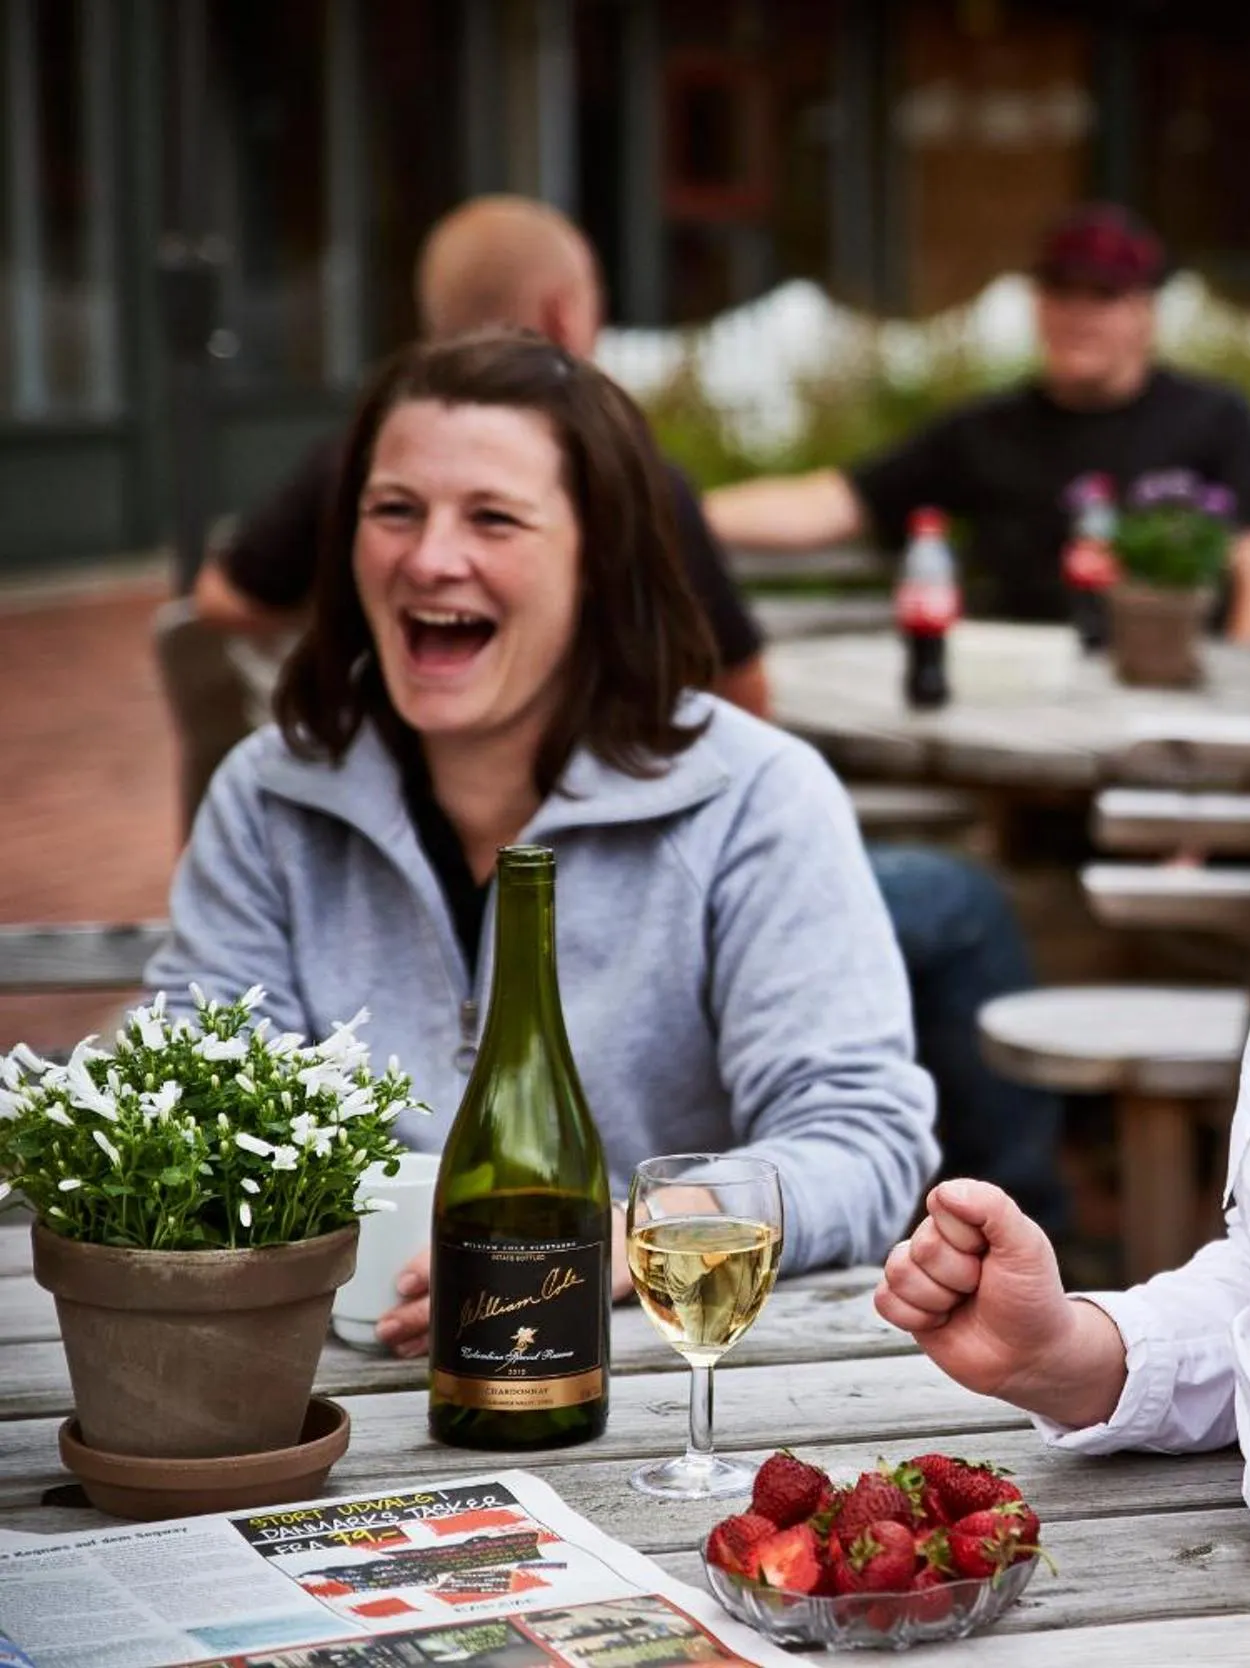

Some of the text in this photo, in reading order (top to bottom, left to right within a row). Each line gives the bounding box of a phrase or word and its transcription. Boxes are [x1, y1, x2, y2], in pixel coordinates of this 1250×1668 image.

[456, 1290, 541, 1339] William
[484, 1386, 549, 1397] CHARDONNAY
[250, 1508, 322, 1530] STORT
[338, 1493, 436, 1517] UDVALG
[259, 1495, 504, 1541] DANMARKS TASKER
[74, 1538, 98, 1549] auf
[101, 1534, 132, 1545] dem
[275, 1541, 326, 1556] FRA
